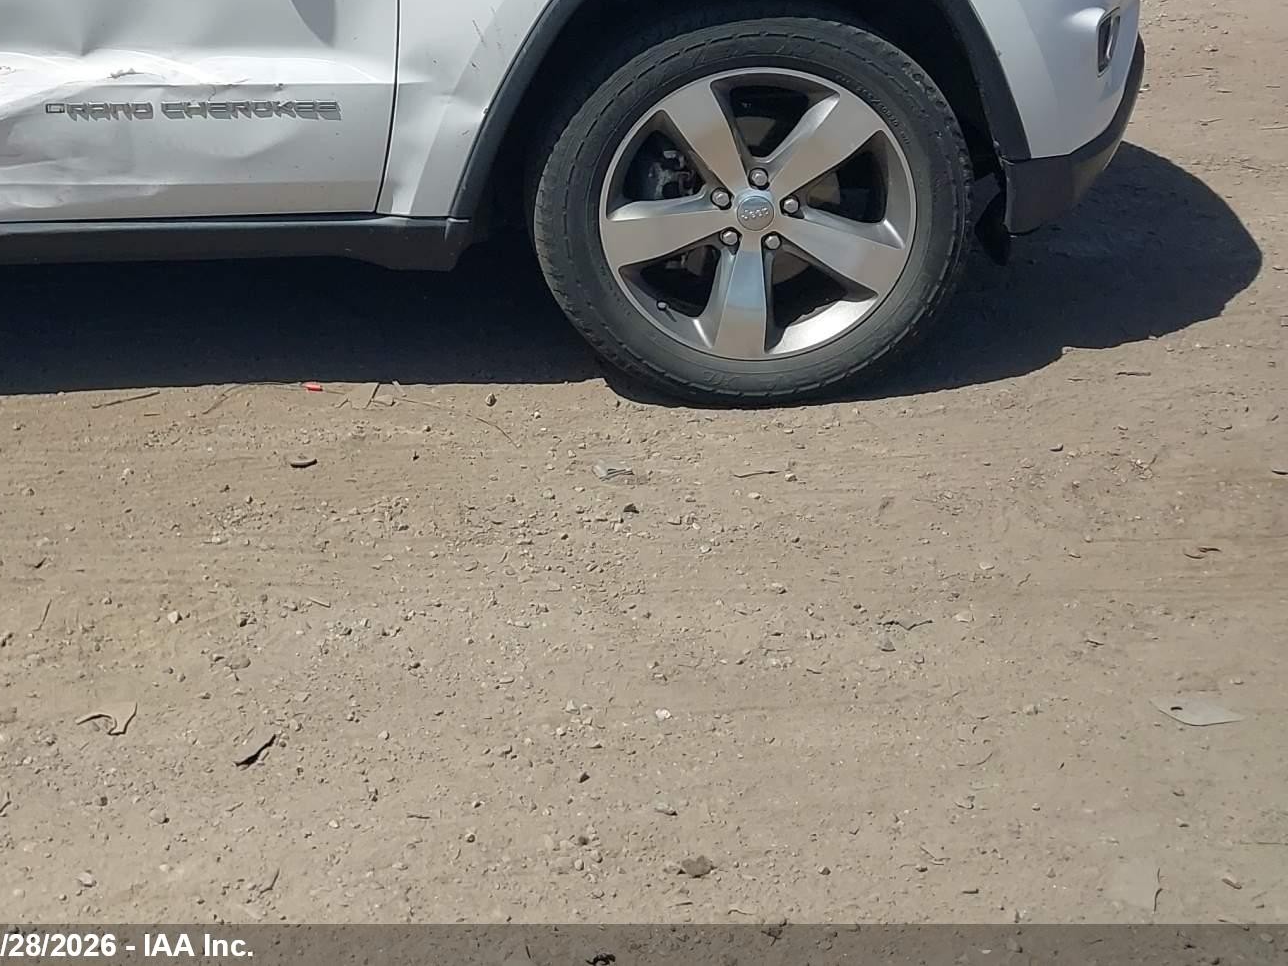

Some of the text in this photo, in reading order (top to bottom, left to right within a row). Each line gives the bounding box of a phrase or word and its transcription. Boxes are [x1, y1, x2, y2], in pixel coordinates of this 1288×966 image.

[45, 99, 342, 121] GRAND CHEROKEE
[741, 207, 769, 220] Jeep
